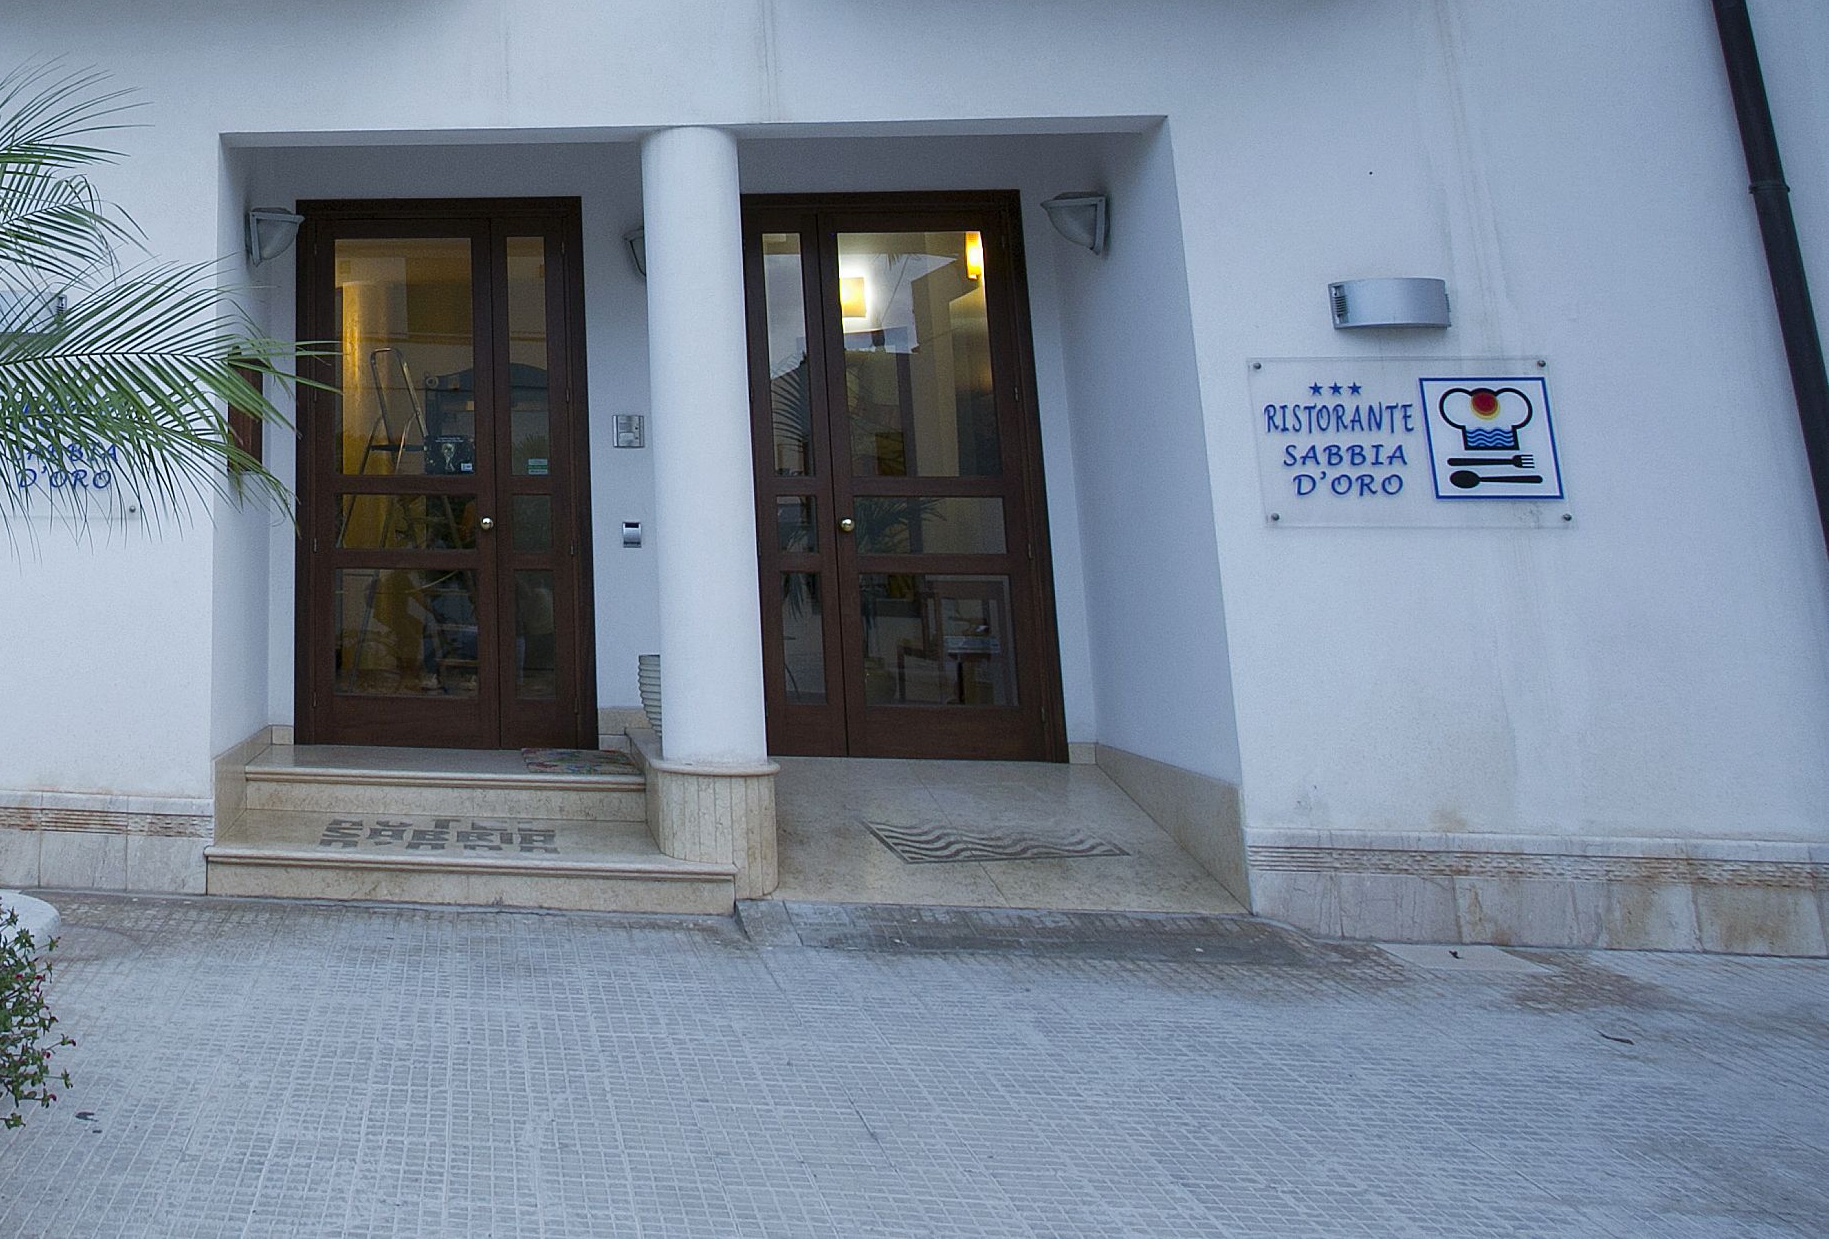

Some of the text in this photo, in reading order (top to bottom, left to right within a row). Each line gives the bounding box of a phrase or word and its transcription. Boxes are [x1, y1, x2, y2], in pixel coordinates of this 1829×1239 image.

[1263, 401, 1414, 434] RISTORANTE
[1283, 443, 1408, 467] SABBIA
[18, 465, 112, 490] D'ORO
[1292, 472, 1404, 497] D'ORO
